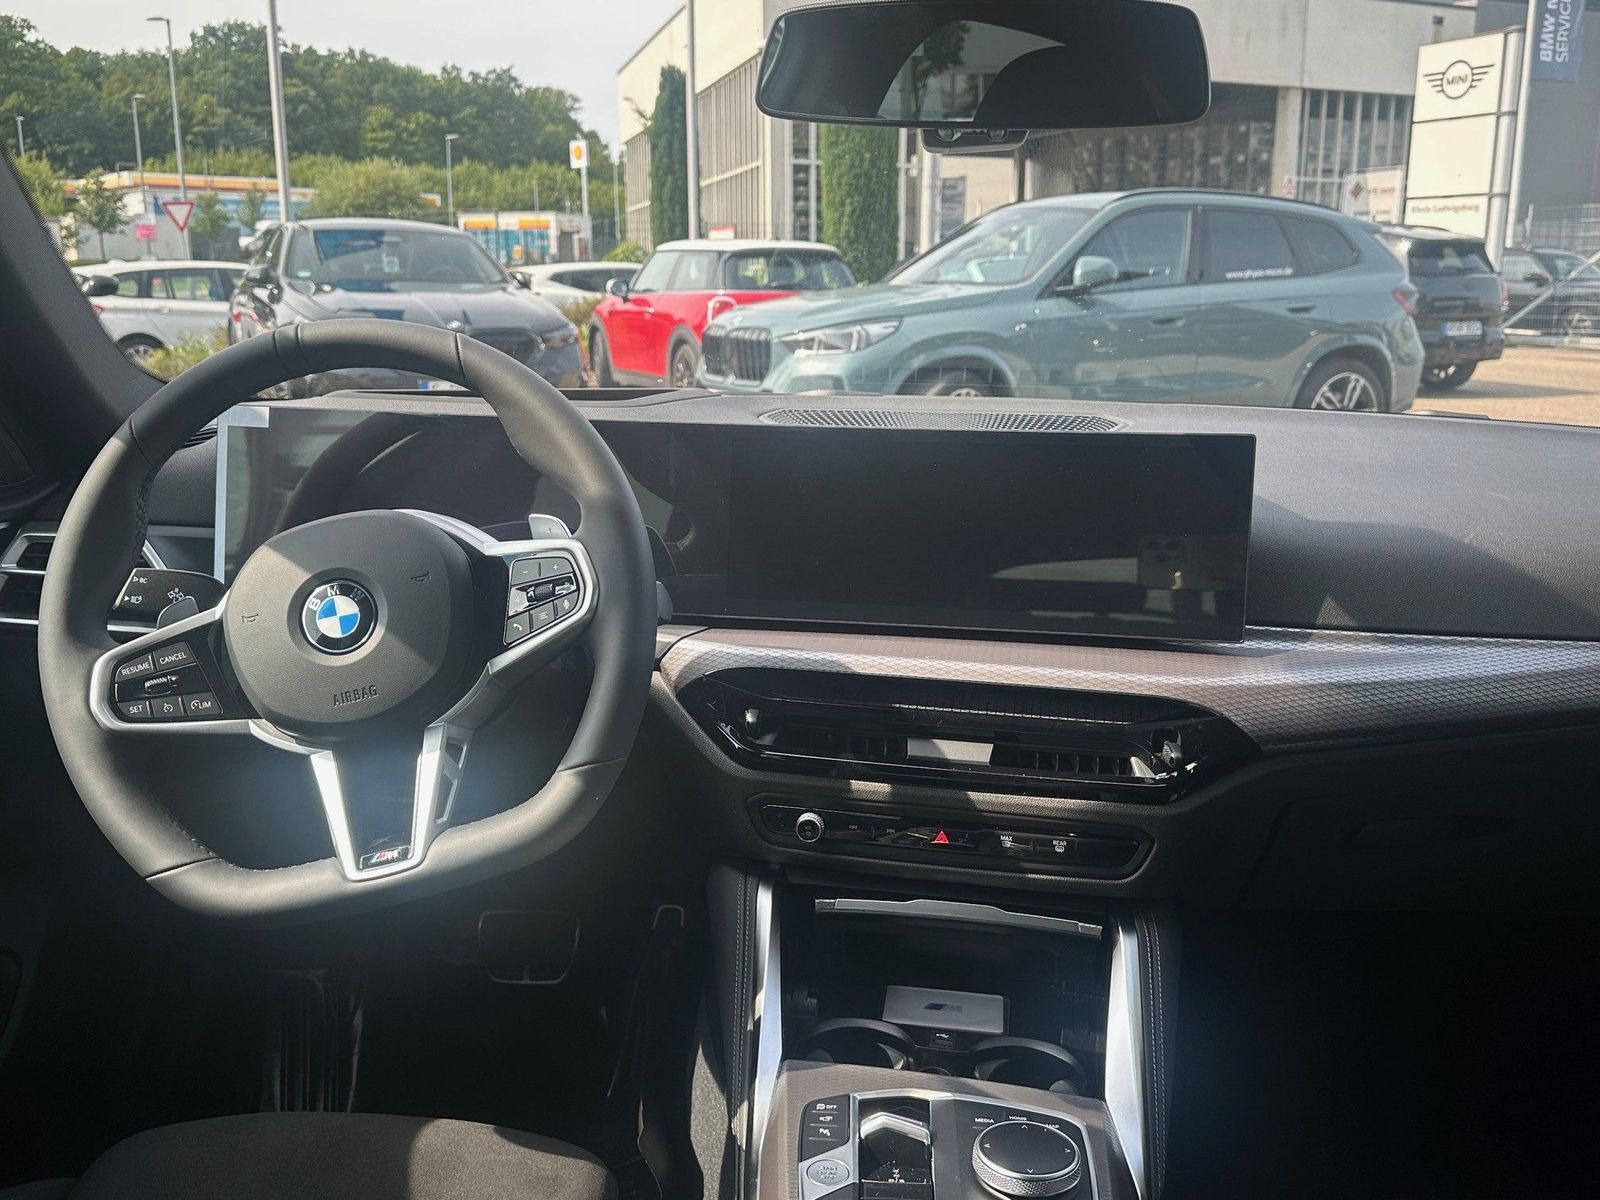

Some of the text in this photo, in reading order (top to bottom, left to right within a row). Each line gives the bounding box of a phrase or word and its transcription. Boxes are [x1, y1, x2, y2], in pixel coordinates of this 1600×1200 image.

[1540, 13, 1555, 62] BMW
[1555, 0, 1571, 63] SERVIC
[1446, 74, 1469, 85] MINI
[308, 585, 366, 611] BMW
[159, 651, 187, 665] CANCEL
[121, 661, 151, 676] RESUME
[333, 684, 378, 707] AIRBAG
[129, 704, 143, 714] SET
[198, 701, 212, 709] LIM
